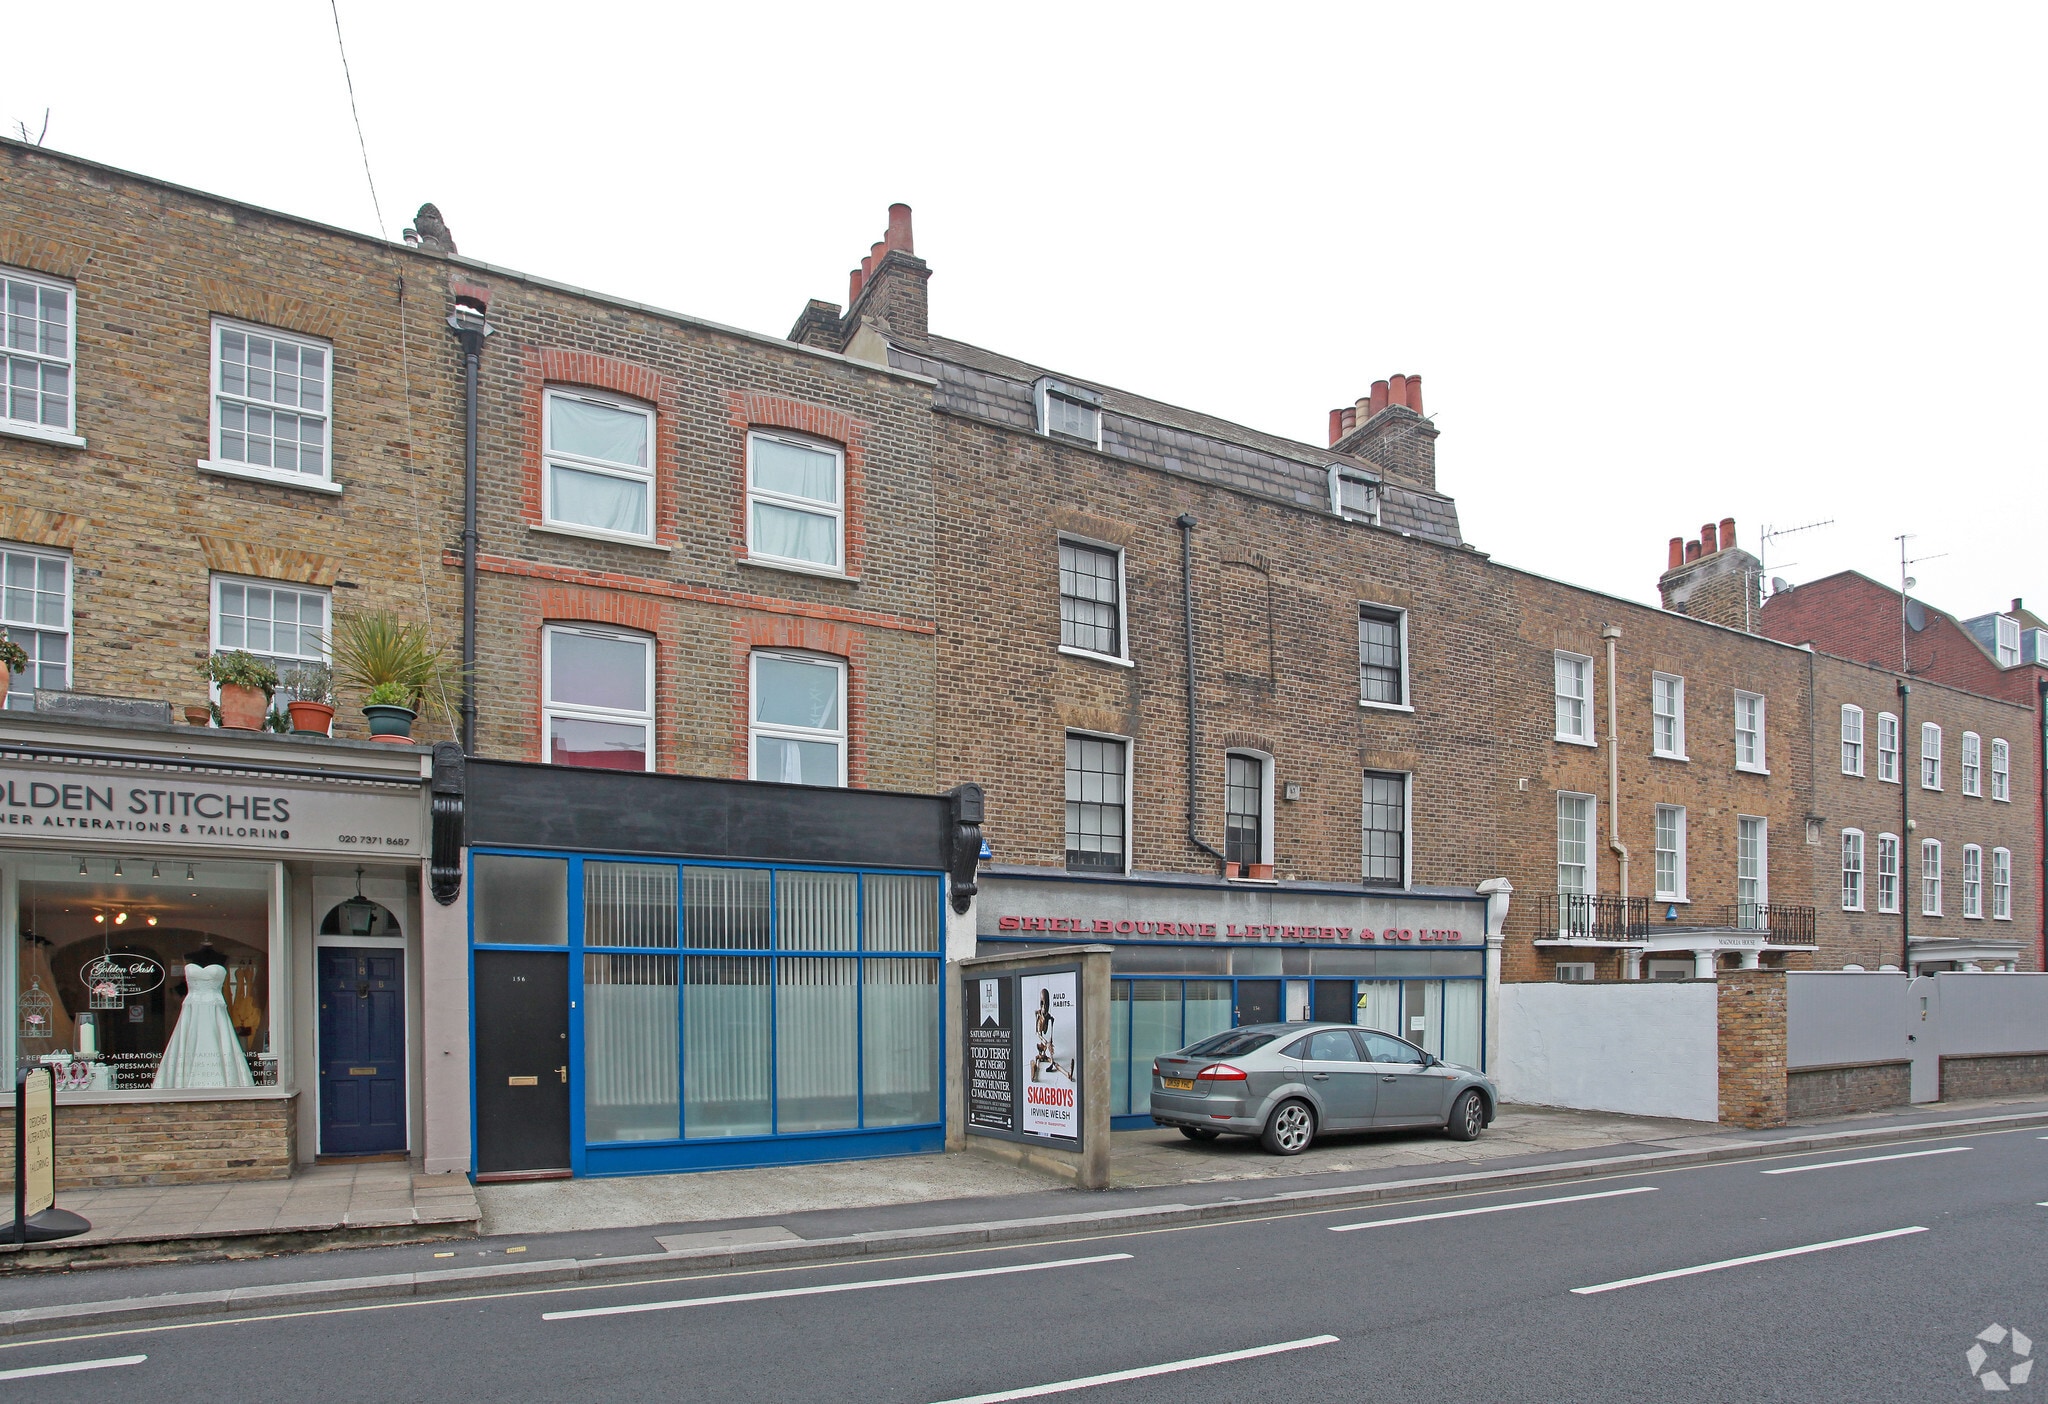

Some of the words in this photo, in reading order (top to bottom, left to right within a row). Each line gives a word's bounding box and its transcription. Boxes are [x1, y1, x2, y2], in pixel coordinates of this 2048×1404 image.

[0, 780, 114, 812] LDEN
[128, 787, 290, 823] STITCHES
[43, 815, 171, 833] ALTERATIONS
[180, 823, 189, 834] &
[198, 824, 290, 840] TAILORING
[338, 834, 357, 843] 020
[360, 836, 382, 845] 7371
[386, 838, 410, 846] 8687
[999, 915, 1218, 937] SHELBOURNE
[1226, 923, 1353, 940] LETHEBY
[1359, 927, 1375, 940] &
[1383, 927, 1413, 941] CO
[1419, 928, 1463, 942] LTD
[90, 961, 127, 976] Golden
[1052, 992, 1066, 1000] AULD
[970, 1030, 993, 1039] SATURDAY
[1000, 1030, 1011, 1039] MAY
[111, 1052, 163, 1060] ALTERATIONS
[970, 1046, 989, 1059] TODD
[988, 1047, 1011, 1060] TERRY
[975, 1059, 988, 1069] JOEY
[987, 1060, 1006, 1070] NEGRO
[974, 1069, 998, 1080] NORMAN
[997, 1070, 1007, 1080] JAY
[972, 1078, 989, 1089] TERRY
[988, 1080, 1010, 1091] HUNTER
[977, 1089, 1011, 1101] MACKINTOSH
[1027, 1085, 1074, 1108] SKAGBOYS
[1030, 1107, 1049, 1118] IRVINE
[1049, 1109, 1071, 1120] WELSH
